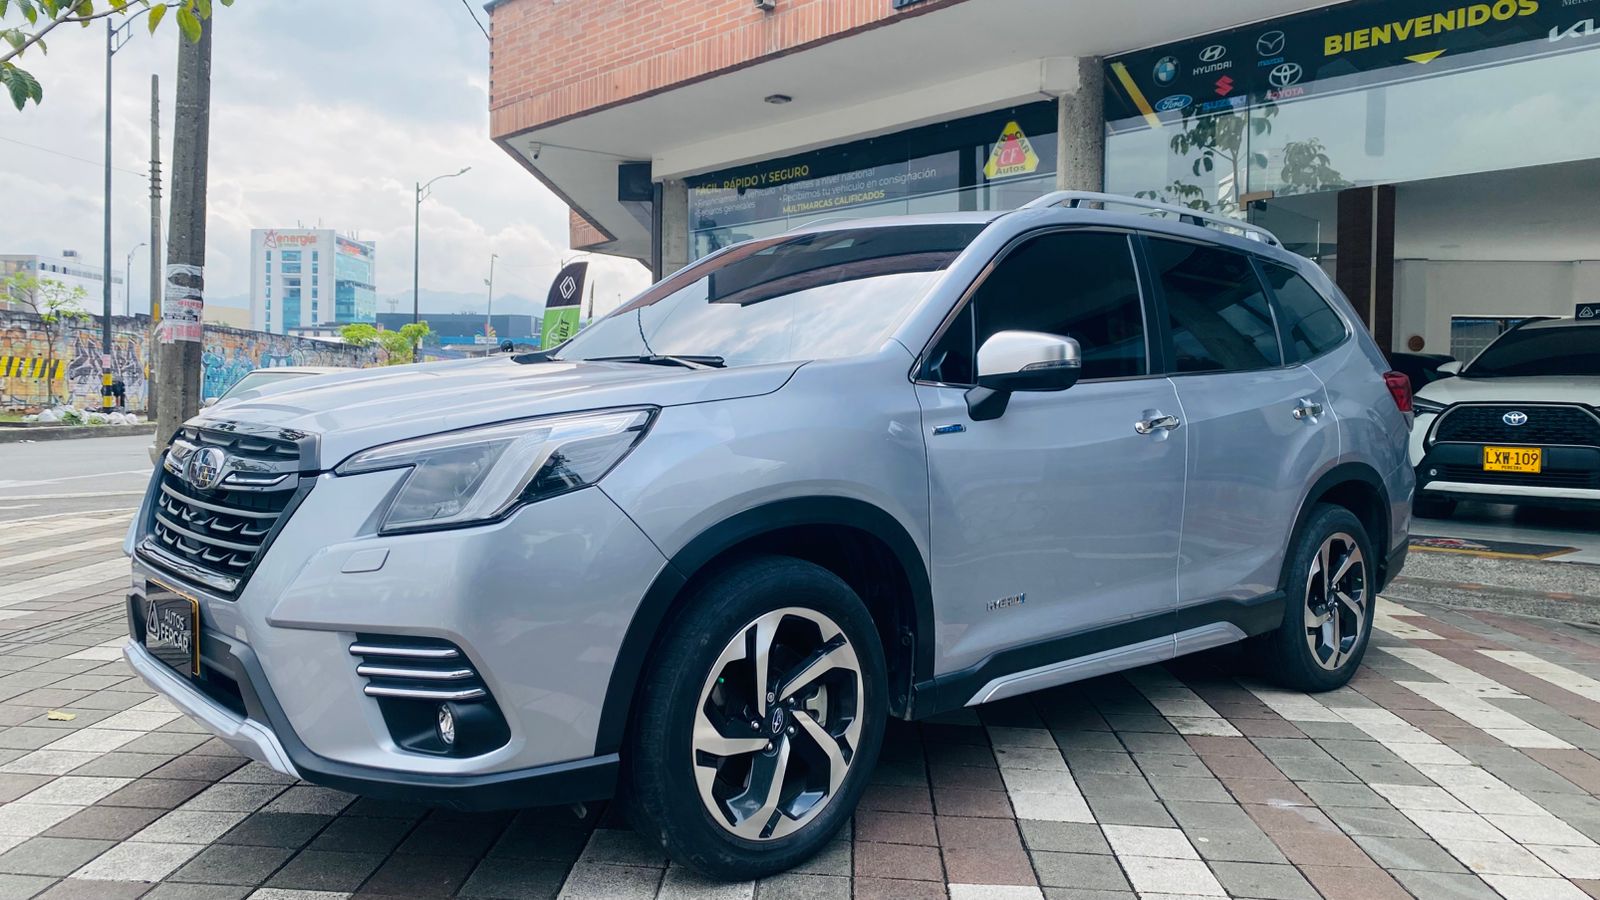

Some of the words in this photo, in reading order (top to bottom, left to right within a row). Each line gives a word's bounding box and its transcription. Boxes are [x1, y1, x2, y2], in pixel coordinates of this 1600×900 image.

[1324, 0, 1539, 56] BIENVENIDOS
[1192, 61, 1233, 76] HYUNDAI
[1162, 96, 1184, 110] Ford
[723, 175, 759, 191] RÁPIDO
[760, 173, 768, 184] Y
[768, 165, 809, 182] SEGURO
[822, 186, 831, 197] tu
[866, 179, 878, 189] en
[879, 167, 937, 186] consignación
[841, 167, 875, 182] nacional
[995, 165, 1026, 175] Autos
[783, 194, 833, 214] MULTIMARCAS
[834, 189, 885, 205] CALIFICADOS
[164, 608, 185, 631] AUTOS
[160, 622, 189, 654] FERCAR
